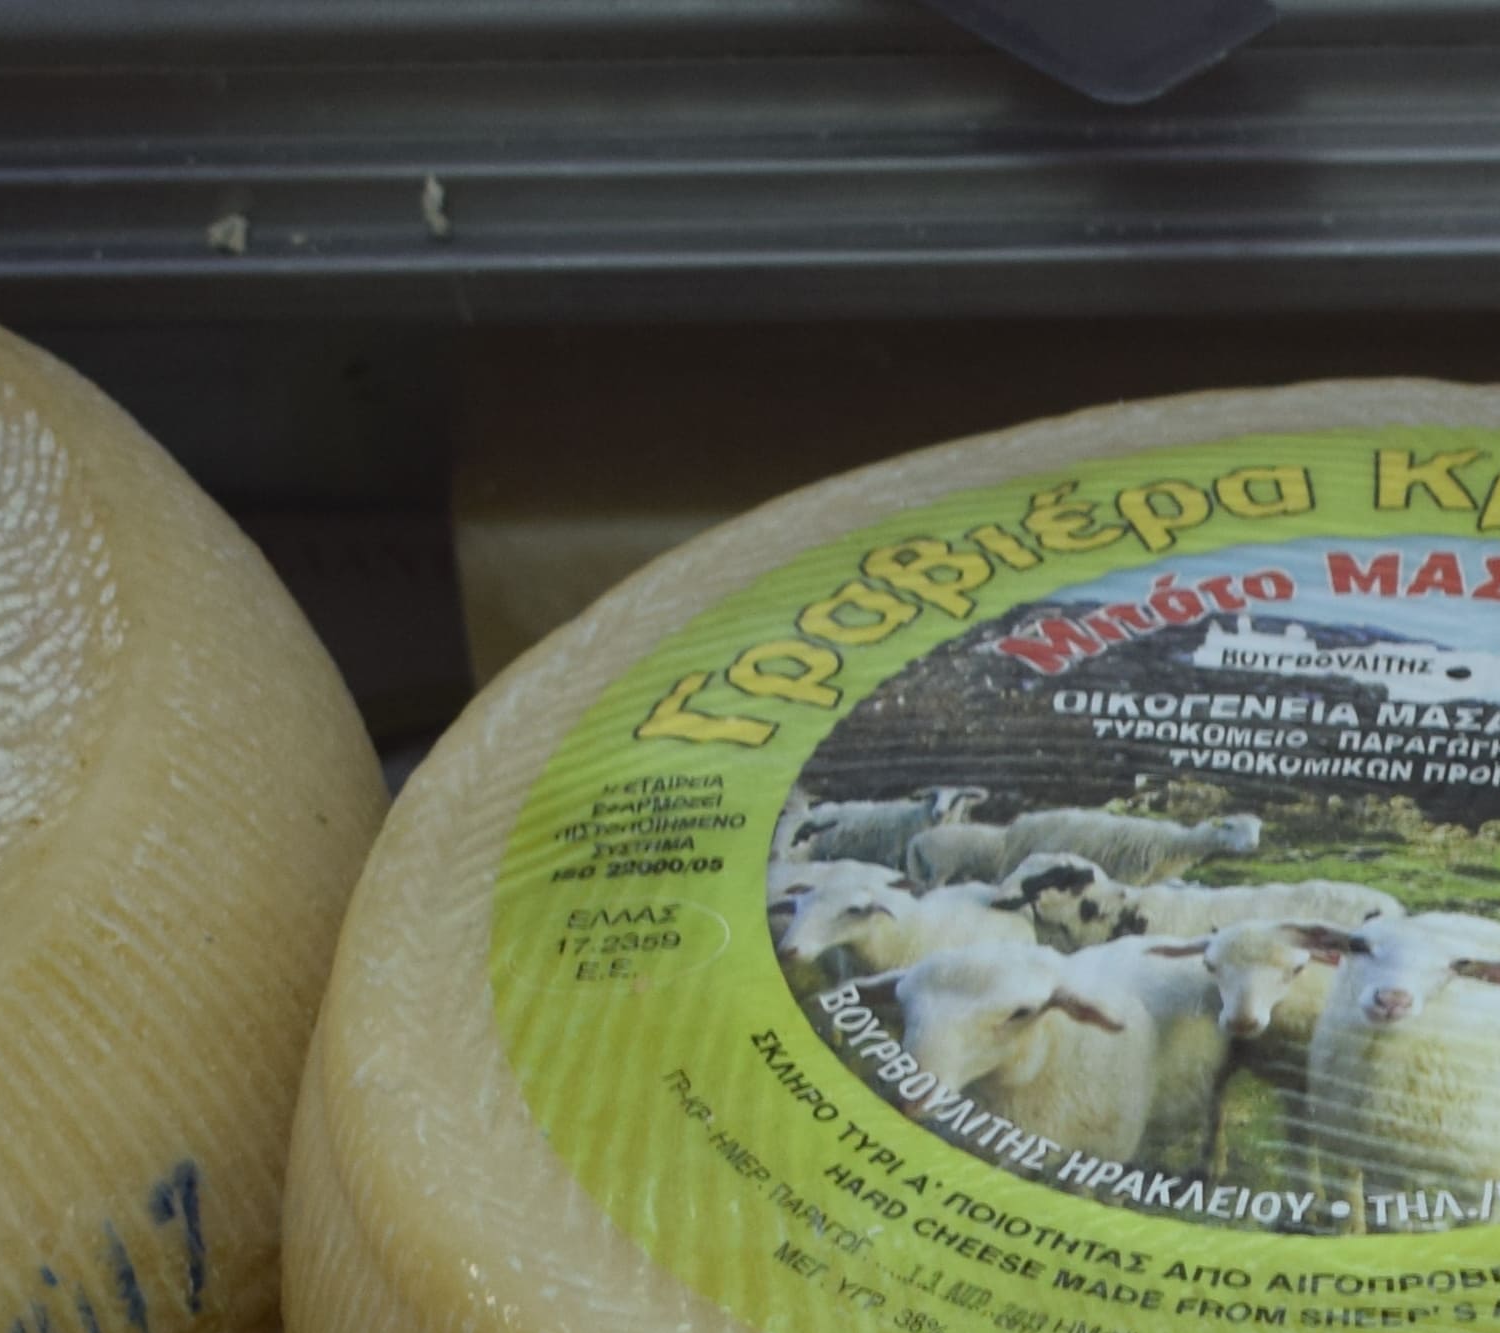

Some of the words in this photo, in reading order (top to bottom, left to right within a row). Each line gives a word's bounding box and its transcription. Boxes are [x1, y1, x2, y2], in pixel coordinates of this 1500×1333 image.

[632, 465, 1316, 748] Γραβιέρα
[1052, 690, 1360, 727] ΟΙΚΟΓΕΝΕΙΑ
[1092, 718, 1308, 748] ΤΥΡΟΚΟΜΕΙΟ
[1168, 748, 1413, 783] ΤΥΡΟΚΟΜΙΚΩΝ
[567, 903, 682, 930] ΕΛΛΑΣ
[818, 981, 1062, 1173] ΒΟΥΡΒΟΥΛΙΤΗΣ
[1056, 1149, 1315, 1225] ΗΡΑΚΛΕΙΟΥ
[750, 1027, 839, 1123] ΣΚΛΗΡΟ
[836, 1120, 905, 1176] ΤΥΡΙ
[941, 1187, 1156, 1274] ΠΟΙΟΤΗΤΑΣ
[1163, 1258, 1254, 1294] ΑΠΟ
[822, 1162, 908, 1221] HARD
[911, 1216, 1057, 1281] CHEESE
[1053, 1268, 1166, 1314] MADE
[1175, 1297, 1290, 1327] FROM
